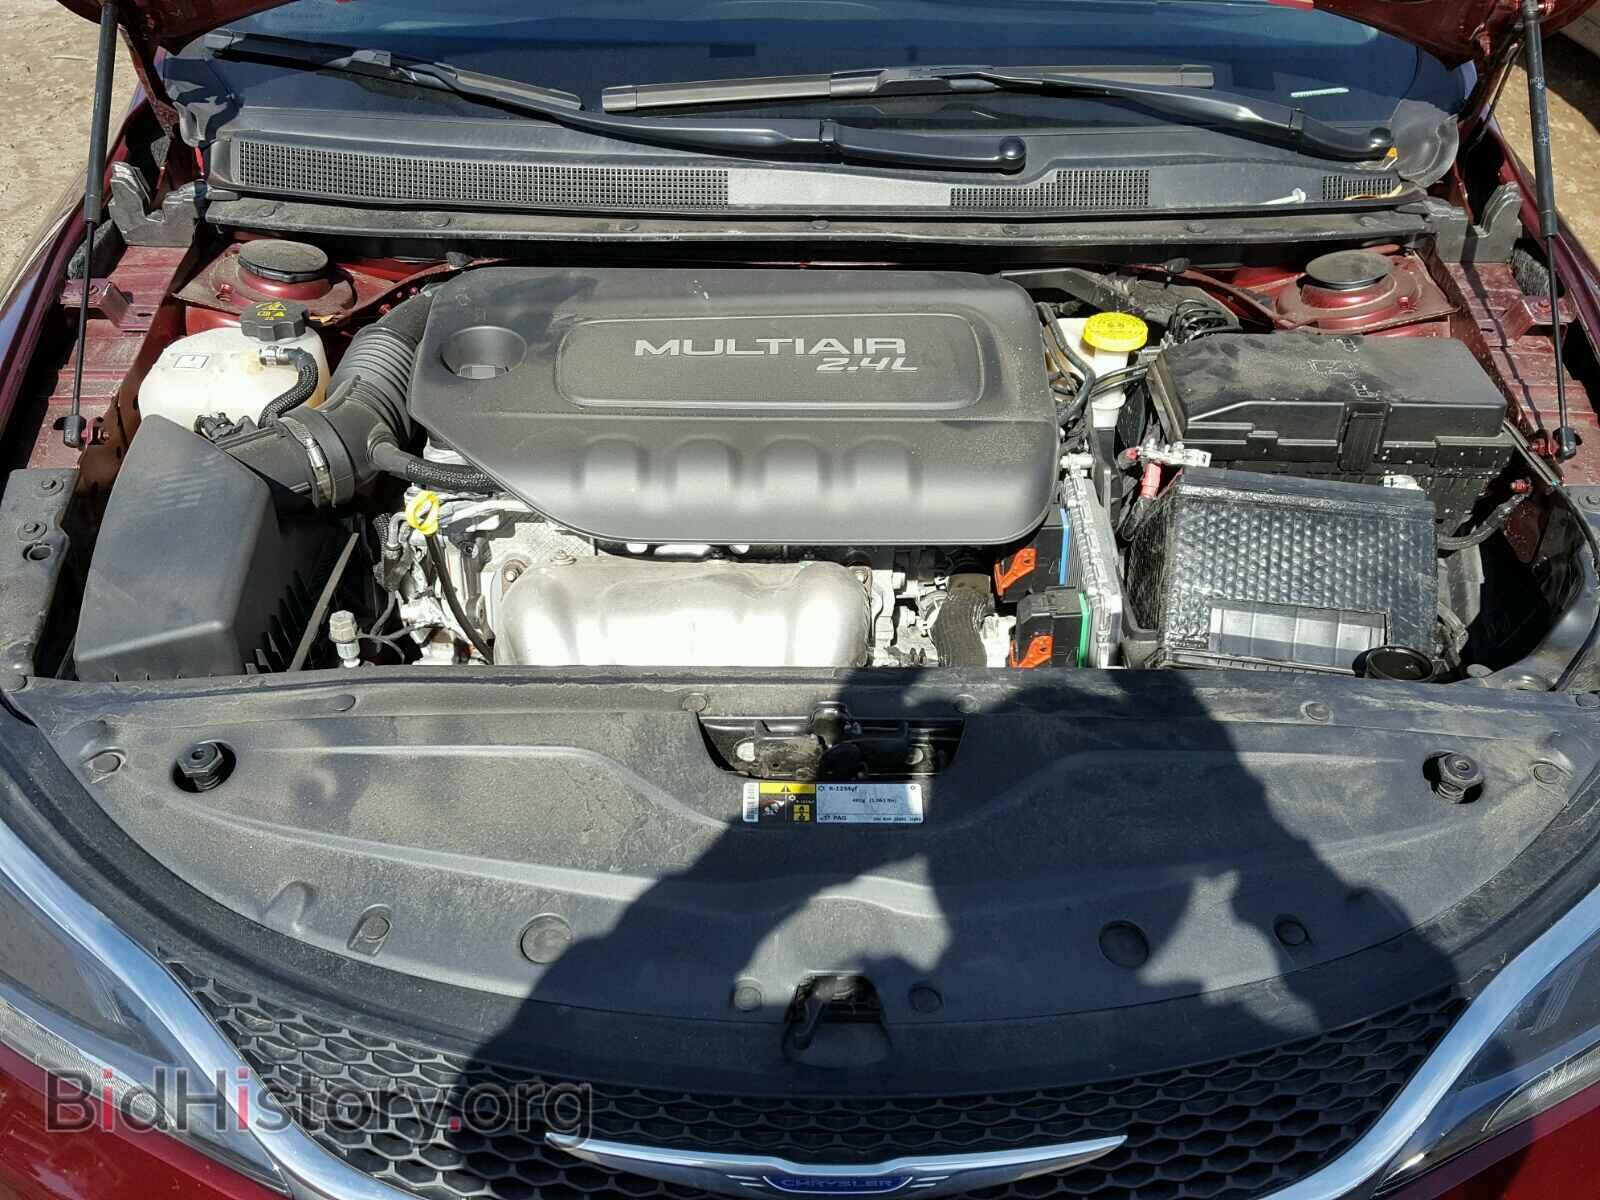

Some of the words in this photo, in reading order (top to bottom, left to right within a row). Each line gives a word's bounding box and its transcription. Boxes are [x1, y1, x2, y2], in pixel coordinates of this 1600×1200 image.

[634, 337, 906, 357] MULTIAIR
[815, 356, 919, 373] 2.4L
[780, 1178, 893, 1188] CHRYSLER
